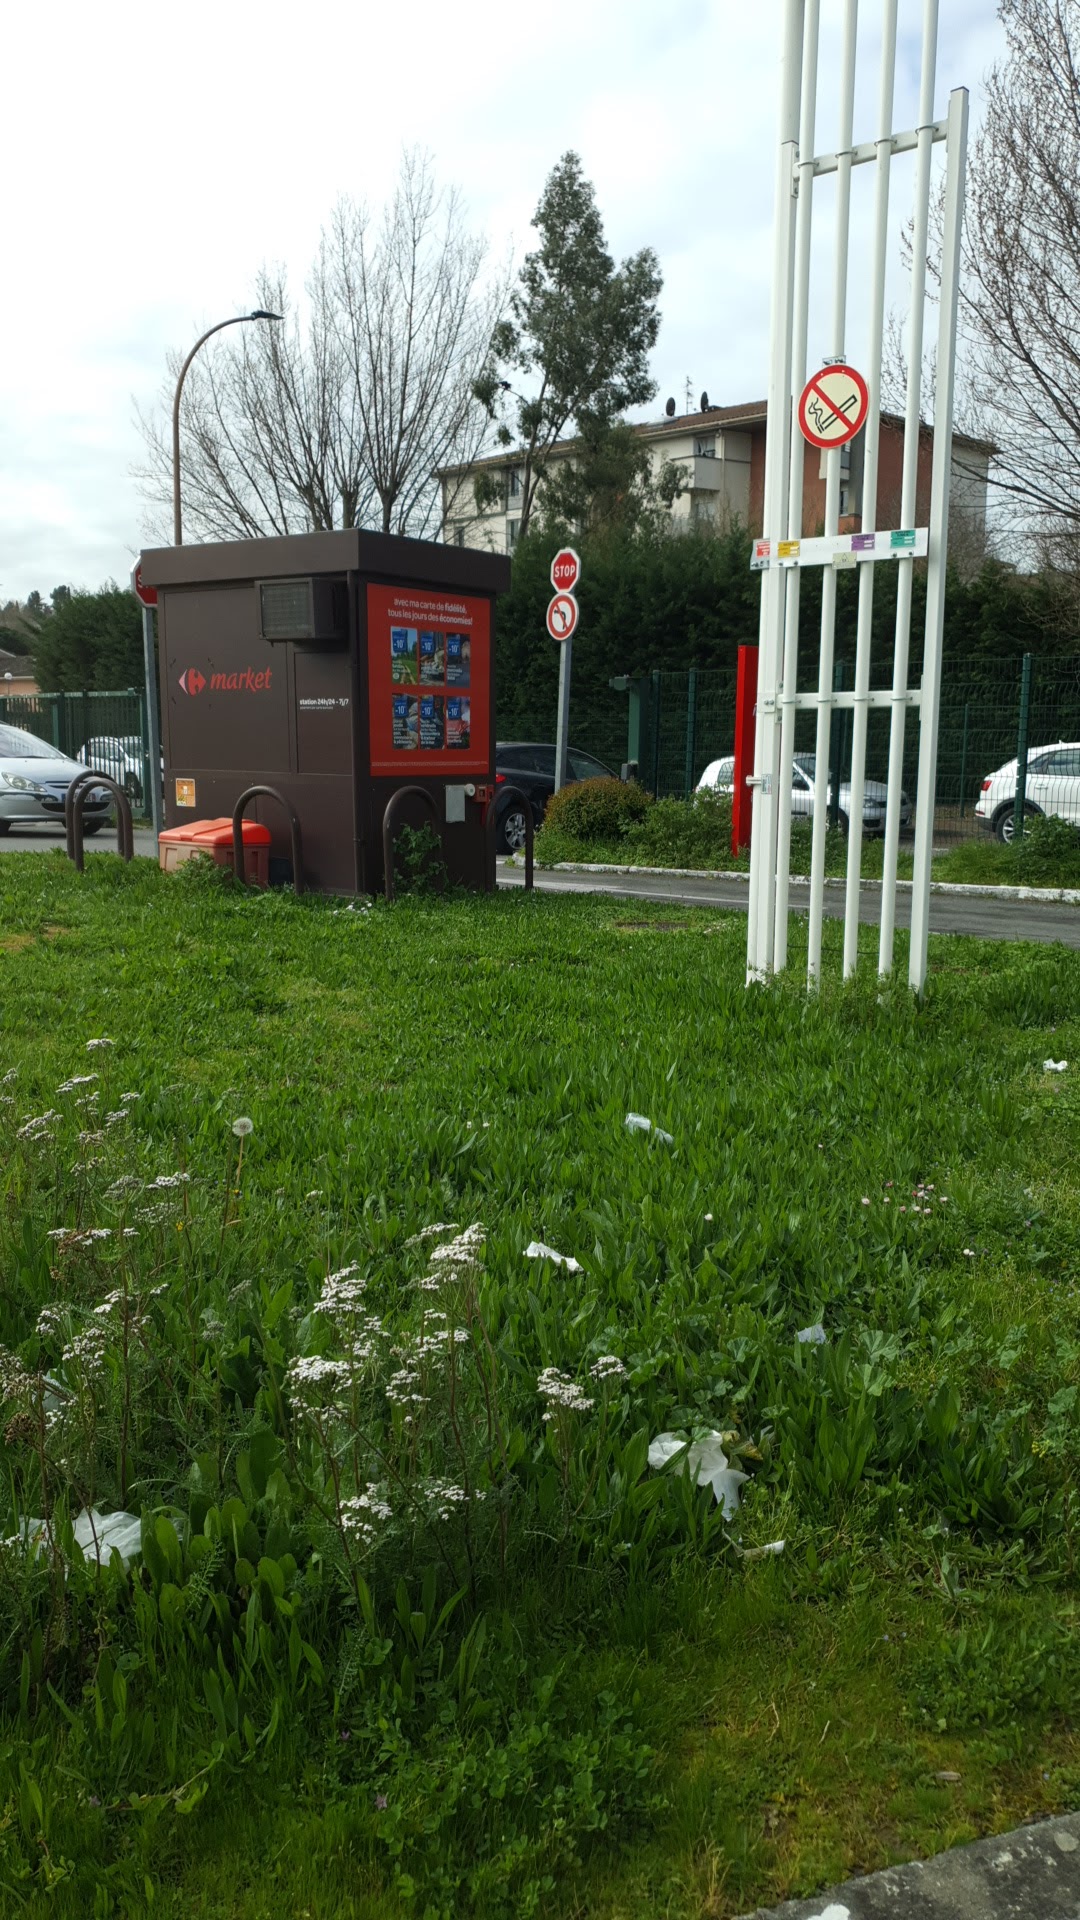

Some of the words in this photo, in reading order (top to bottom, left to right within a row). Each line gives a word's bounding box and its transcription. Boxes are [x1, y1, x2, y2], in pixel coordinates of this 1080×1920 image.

[554, 565, 576, 578] STOP
[393, 598, 409, 607] avec
[409, 600, 420, 608] ma
[420, 601, 436, 610] carte
[436, 602, 444, 611] de
[387, 608, 402, 618] tous
[402, 609, 412, 619] les
[411, 610, 427, 621] jours
[427, 612, 439, 622] des
[210, 666, 273, 692] market
